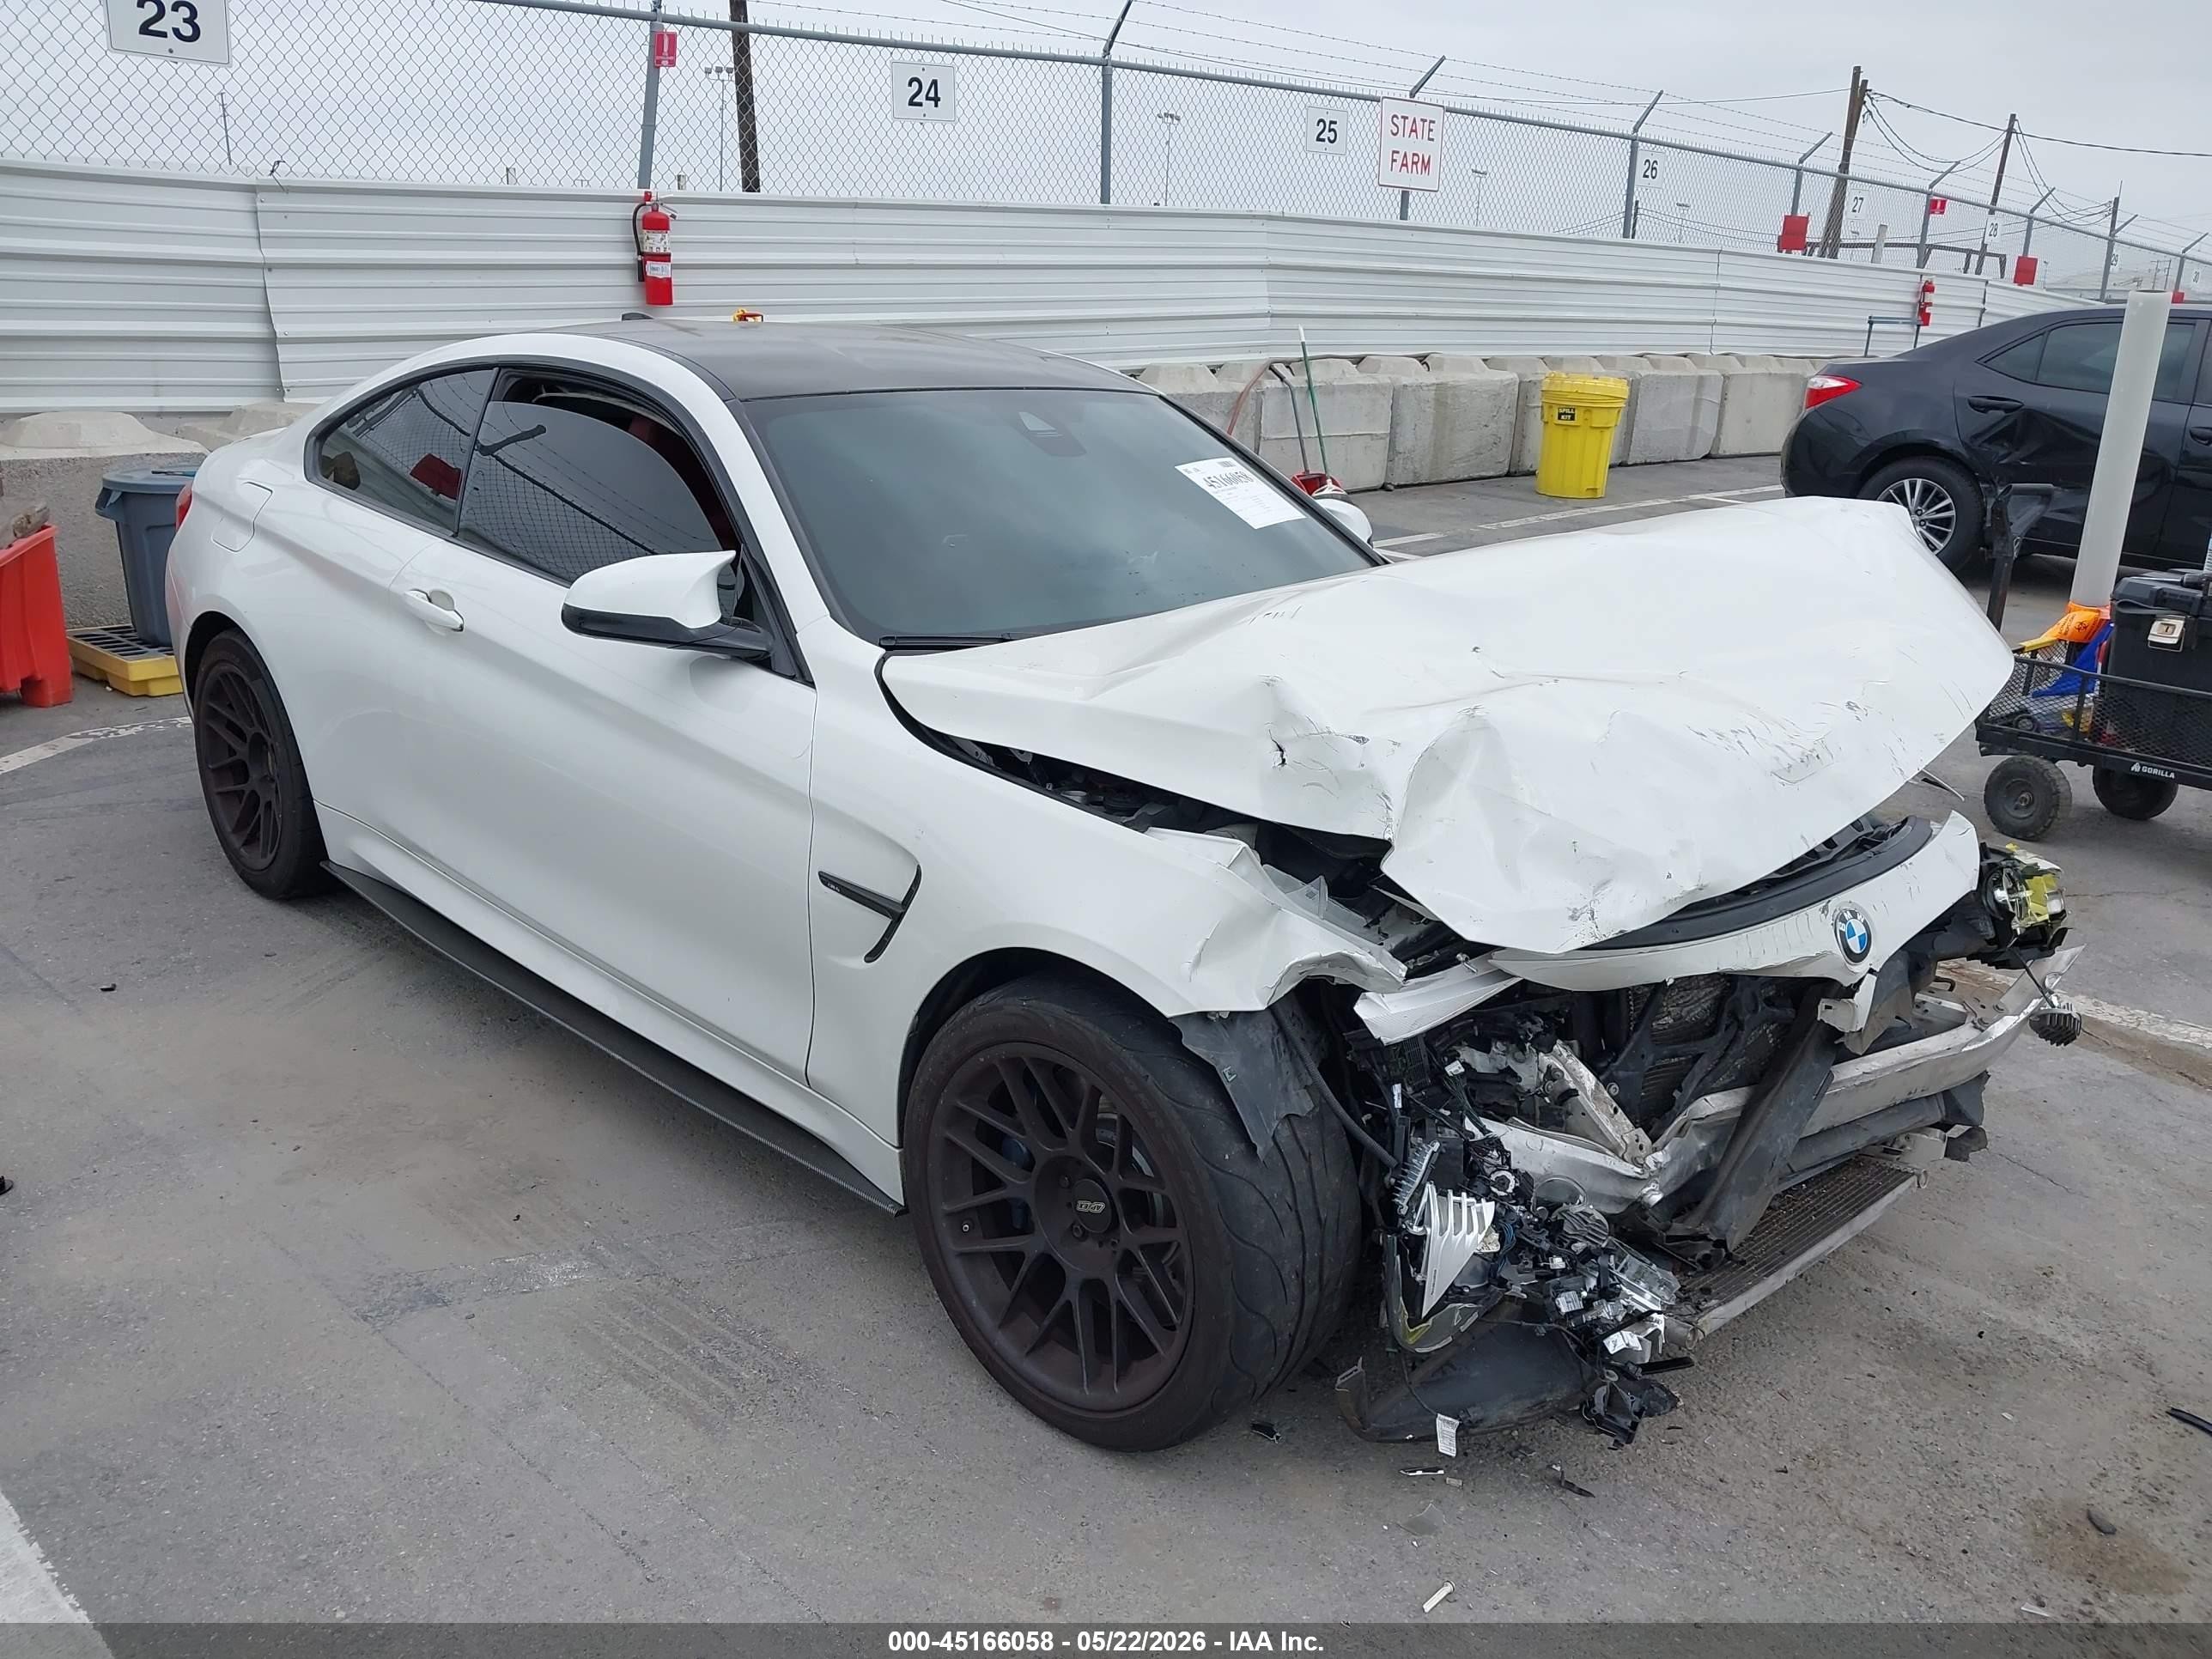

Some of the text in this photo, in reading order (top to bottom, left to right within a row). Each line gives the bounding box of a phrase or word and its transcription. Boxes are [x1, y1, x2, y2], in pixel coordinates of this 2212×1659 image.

[137, 0, 201, 43] 23
[908, 76, 941, 108] 24
[1316, 118, 1338, 144] 25
[1390, 114, 1436, 142] STATE
[1390, 150, 1431, 176] FARM
[1643, 159, 1658, 179] 26
[1852, 196, 1864, 214] 27
[1989, 222, 1999, 238] 28
[2142, 766, 2175, 779] GORILLA
[1838, 910, 1865, 933] BMW
